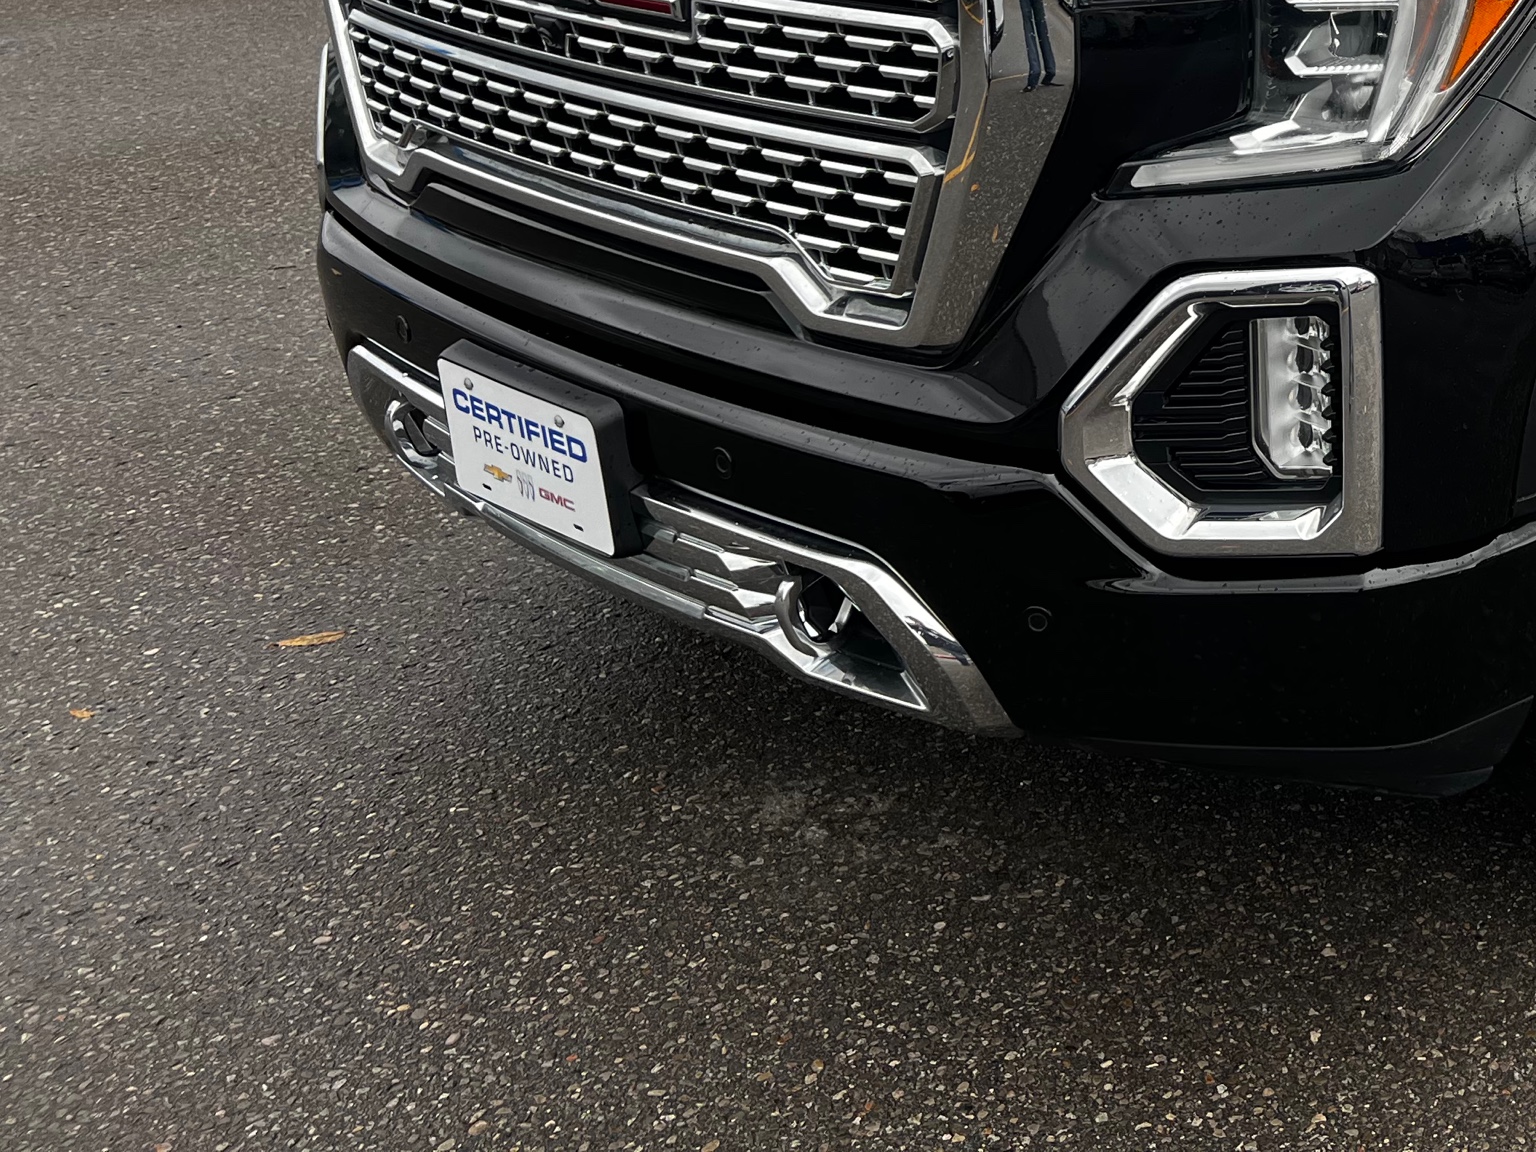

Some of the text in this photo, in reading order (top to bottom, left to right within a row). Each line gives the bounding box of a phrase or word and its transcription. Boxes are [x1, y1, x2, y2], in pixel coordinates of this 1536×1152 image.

[452, 387, 588, 463] CERTIFIED
[472, 425, 574, 484] PRE-OWNED
[539, 487, 576, 513] GMC
